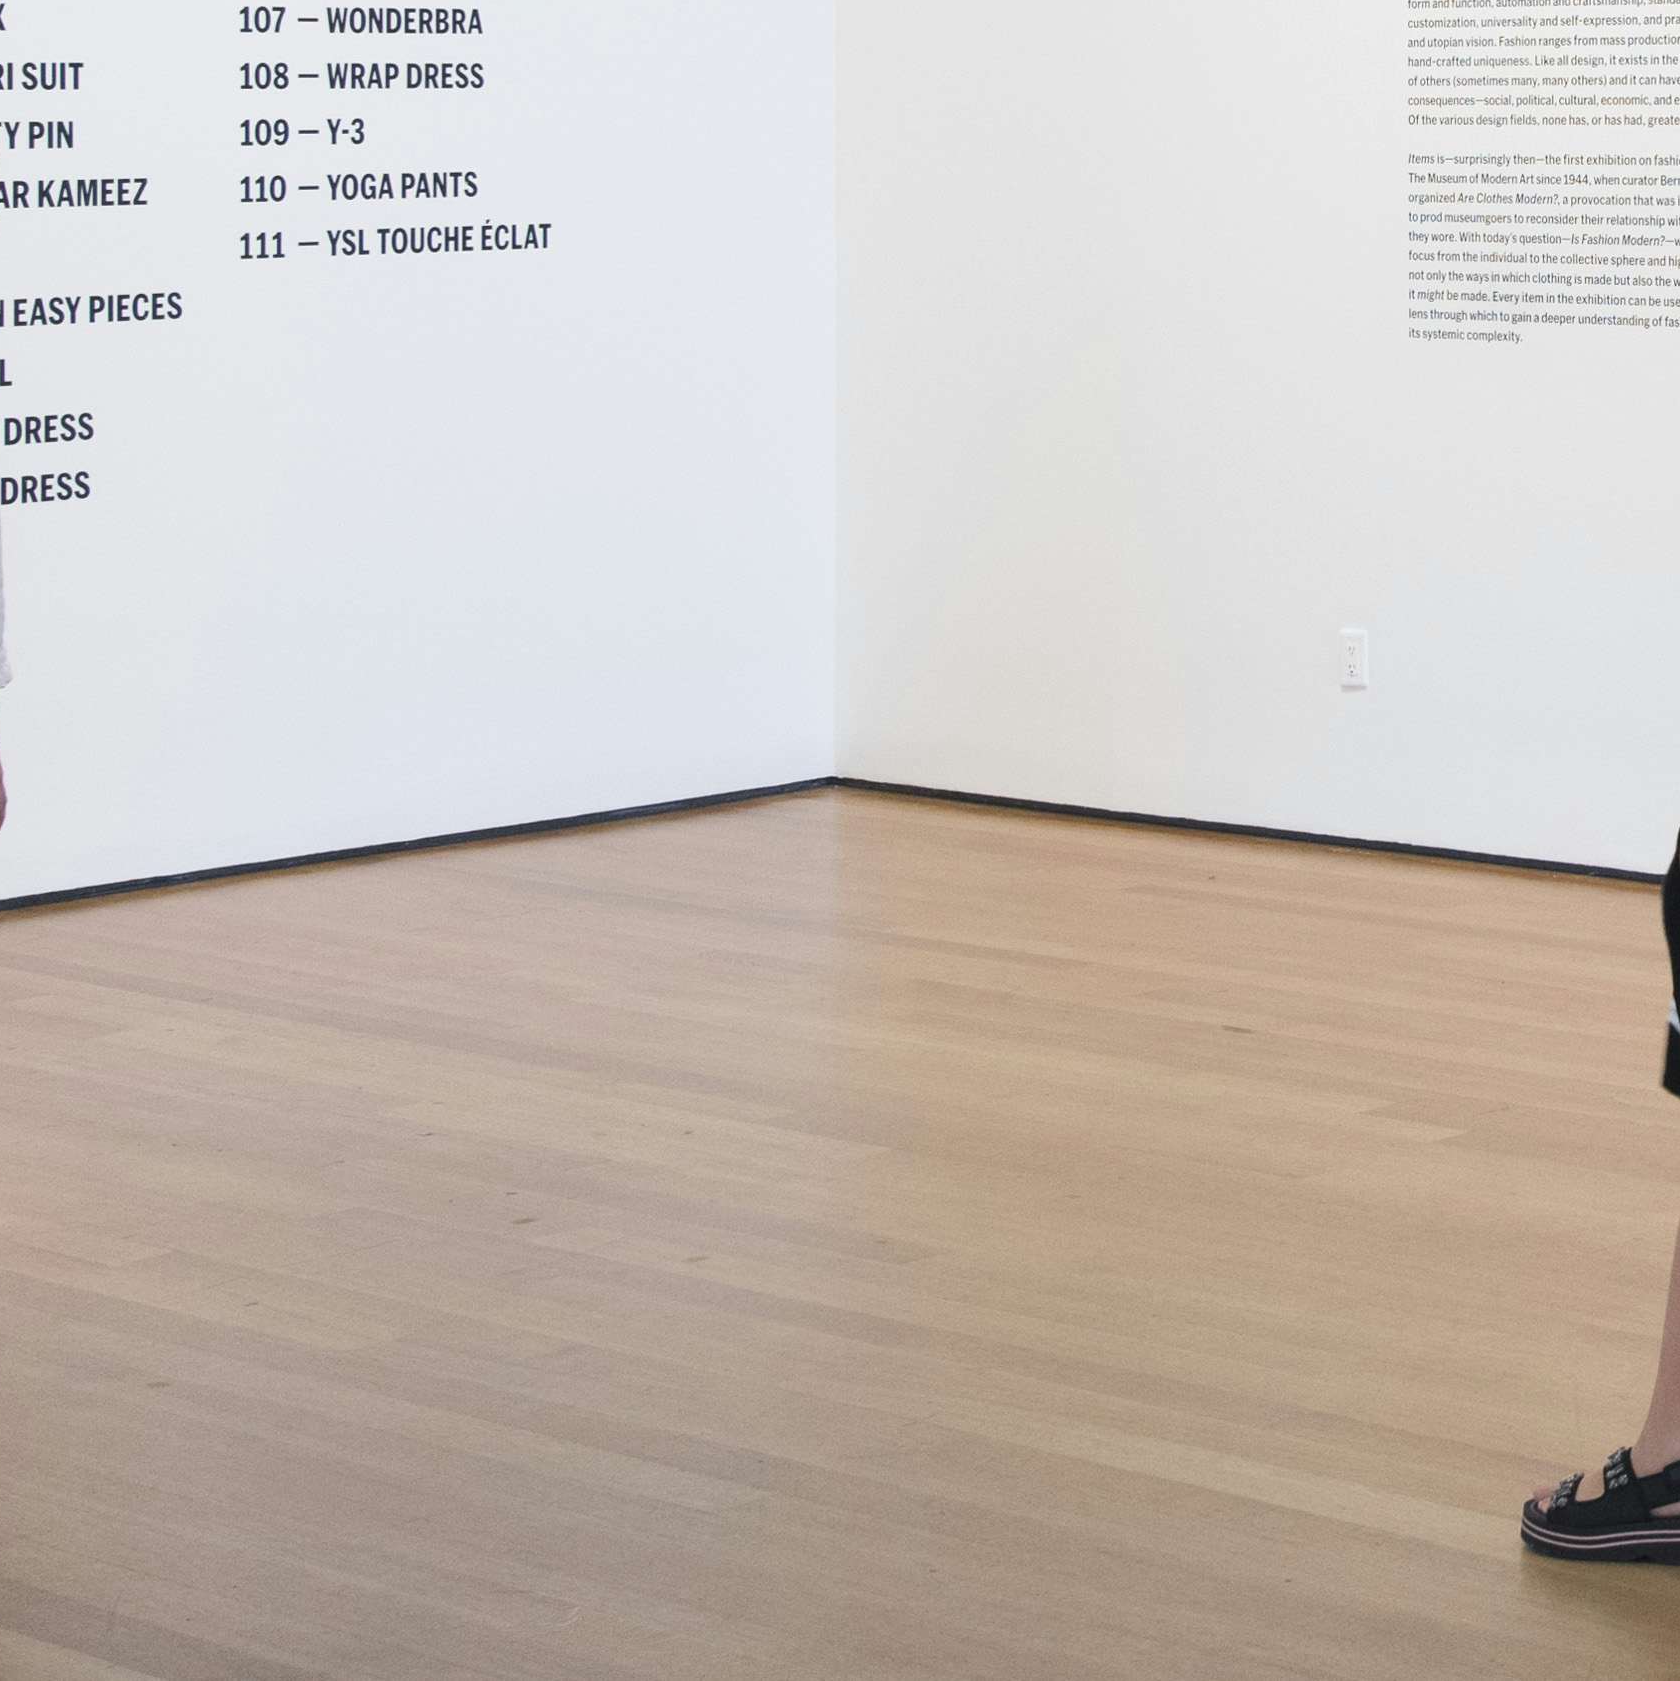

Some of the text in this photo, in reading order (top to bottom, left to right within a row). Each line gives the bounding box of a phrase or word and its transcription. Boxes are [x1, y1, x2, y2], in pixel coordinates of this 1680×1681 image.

[240, 6, 483, 34] 107 WONDERBRA
[22, 62, 83, 90] SUIT
[1408, 114, 1420, 126] Of
[1421, 114, 1437, 126] the
[1439, 115, 1474, 126] various
[1476, 114, 1508, 128] design
[1510, 114, 1540, 127] fields,
[1542, 117, 1567, 126] none
[1568, 114, 1590, 127] has,
[1591, 117, 1602, 126] or
[1604, 114, 1622, 126] has
[1623, 114, 1646, 127] had,
[1408, 171, 1427, 184] The
[1427, 171, 1468, 184] Museum
[1469, 172, 1480, 185] of
[1481, 173, 1518, 185] Modern
[1519, 173, 1535, 185] Art
[1536, 173, 1562, 185] since
[1563, 173, 1593, 187] 1944,
[1593, 173, 1621, 187] when
[1620, 174, 1660, 187] curator
[241, 220, 552, 259] 111 YSL TOUCHE ÉCLAT
